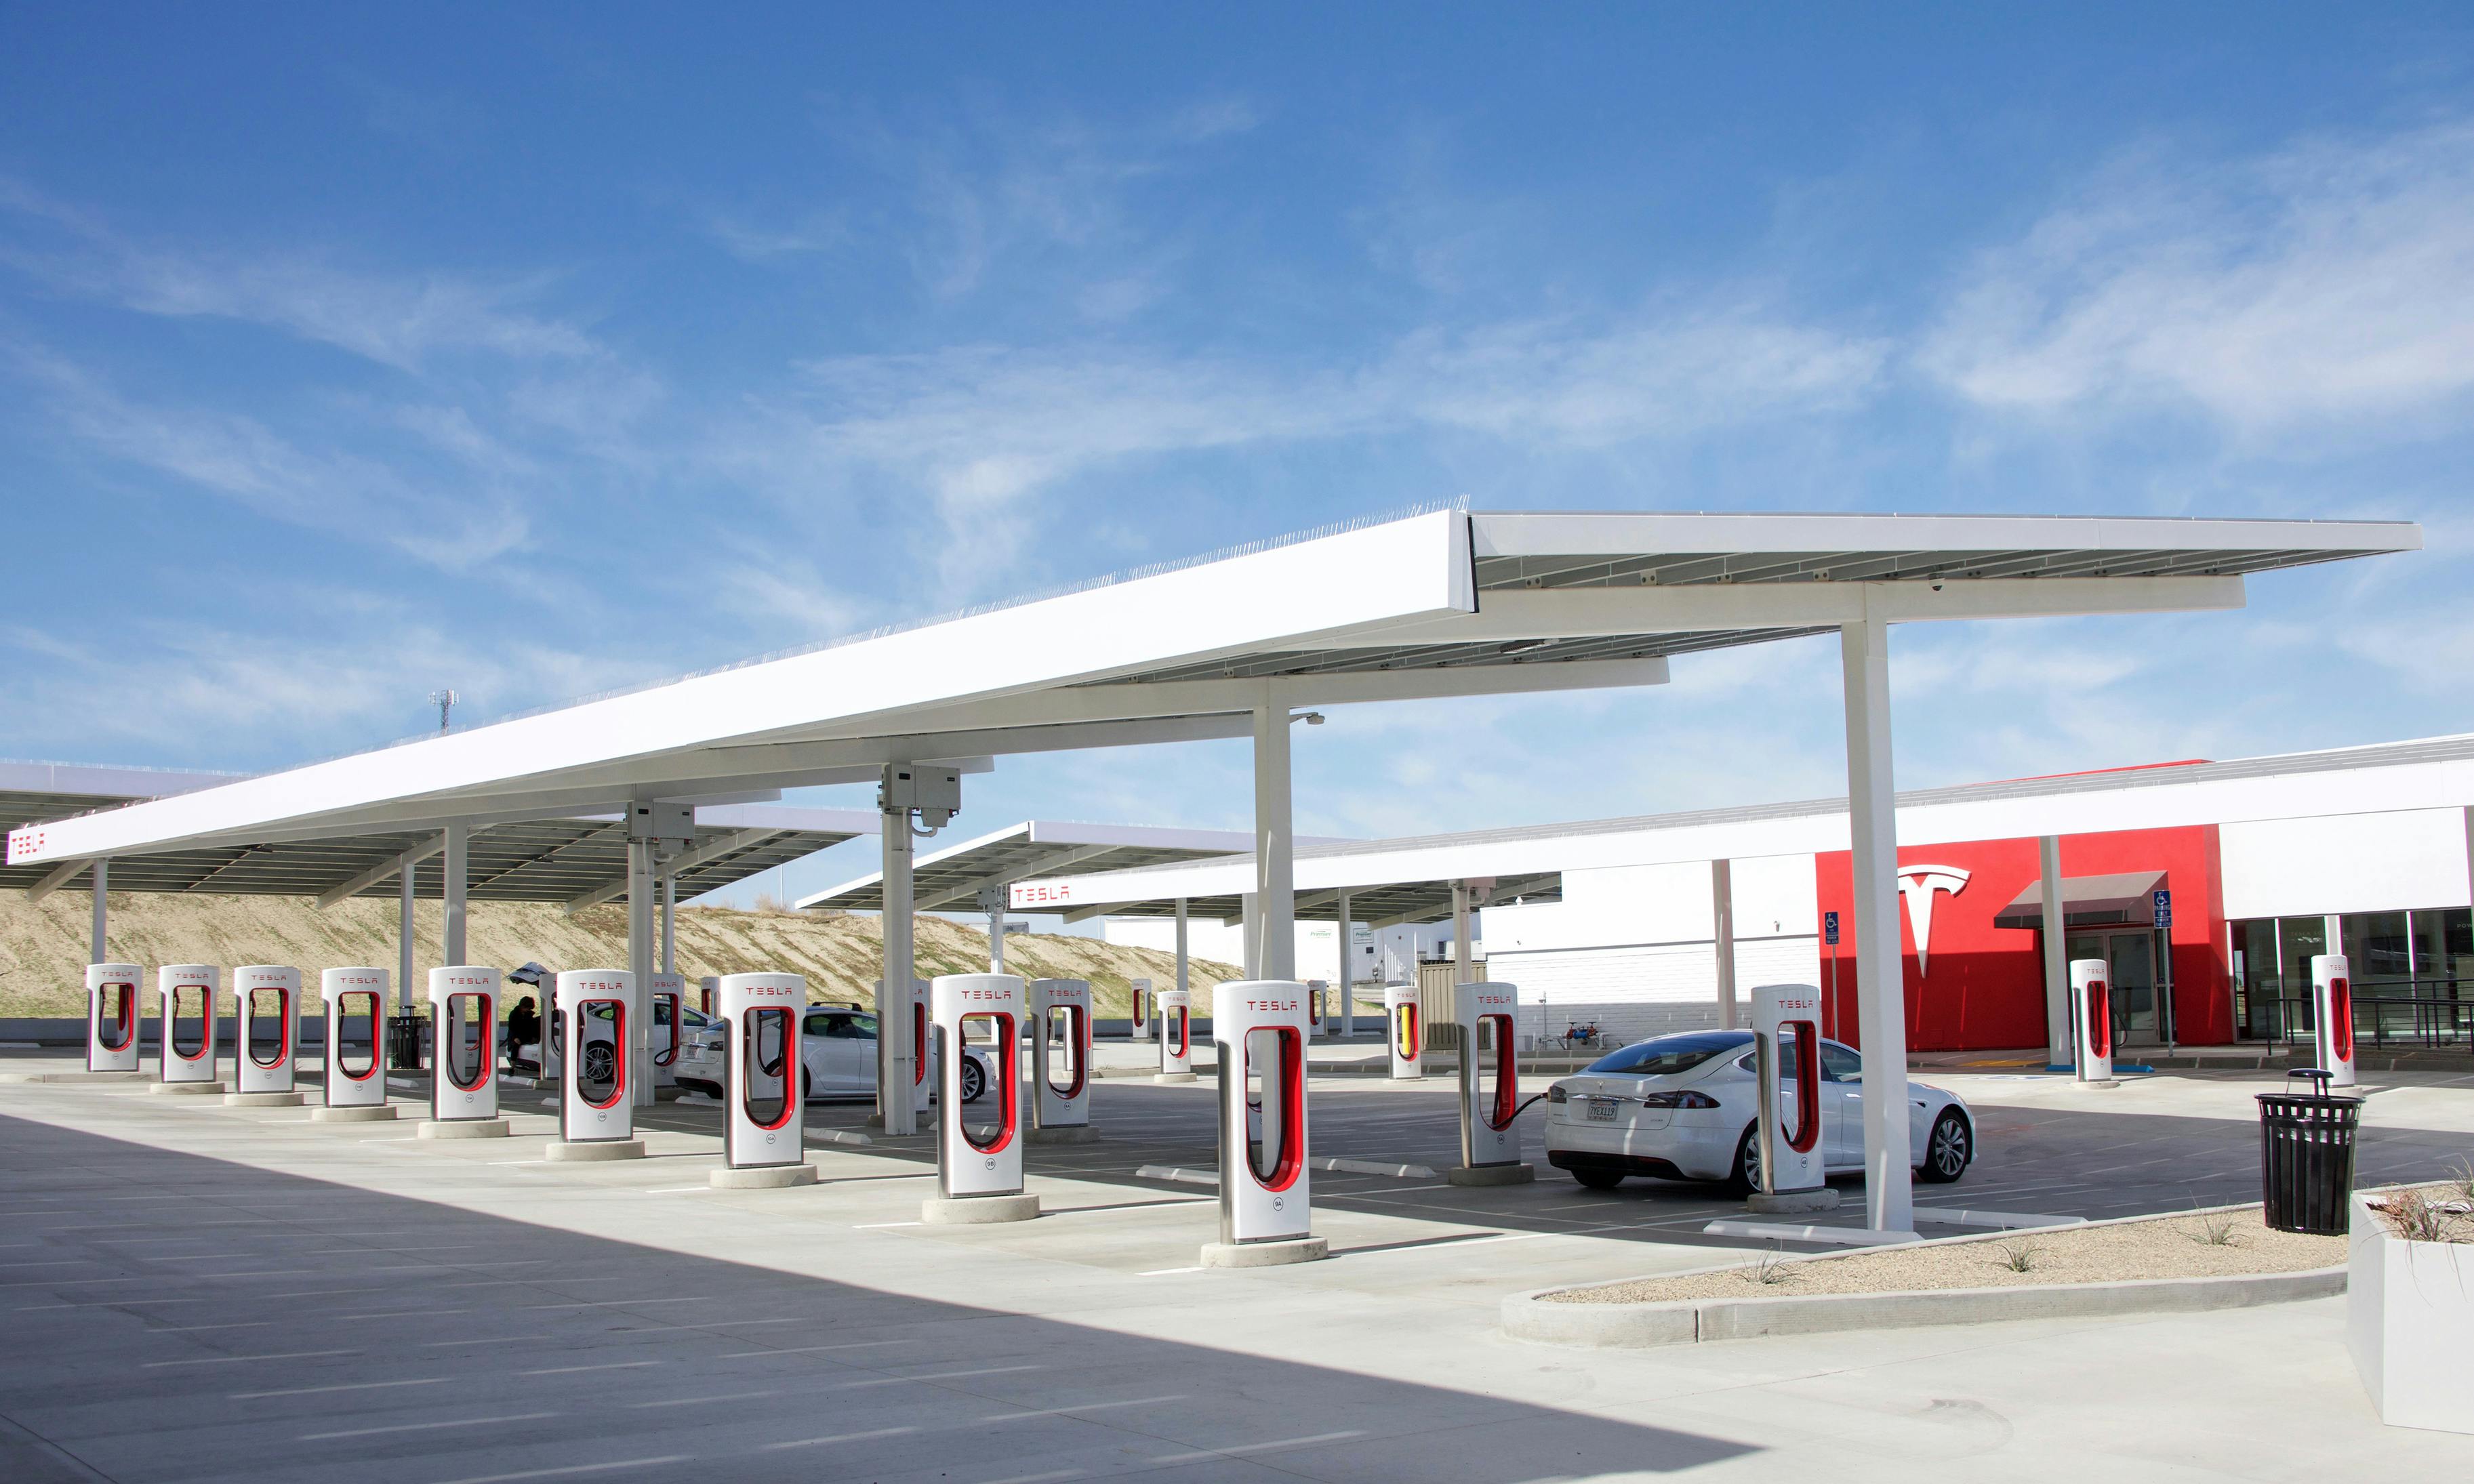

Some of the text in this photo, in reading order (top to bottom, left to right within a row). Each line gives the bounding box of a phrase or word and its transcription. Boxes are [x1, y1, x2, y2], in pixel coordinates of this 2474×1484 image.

[12, 833, 46, 855] TESLA
[1015, 886, 1069, 902] TESLA
[961, 991, 1011, 999] TESLA
[1247, 1001, 1297, 1010] TESLA
[1779, 1000, 1813, 1008] TESLA
[1590, 1107, 1615, 1116] 7YEX119
